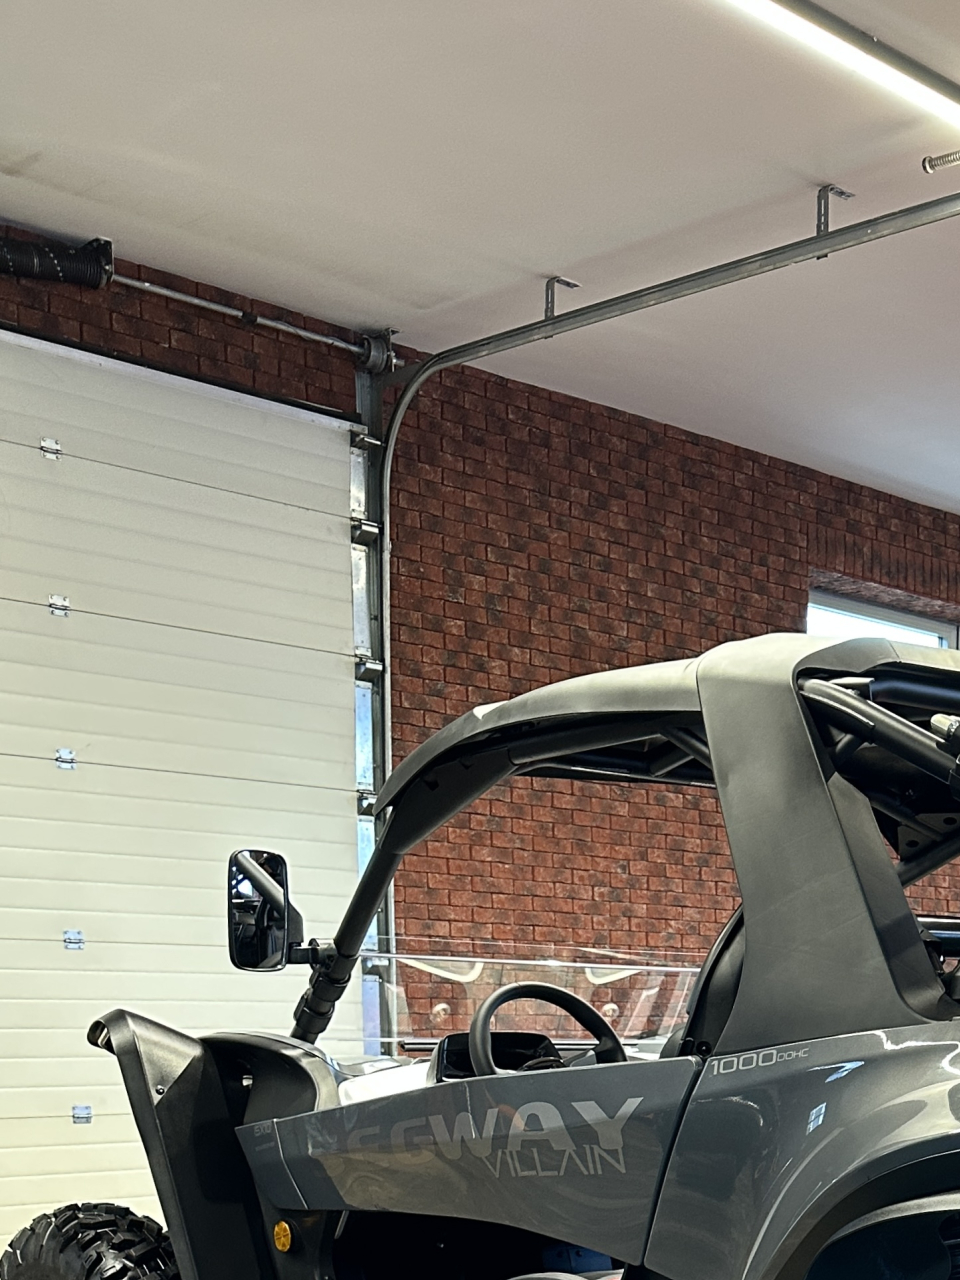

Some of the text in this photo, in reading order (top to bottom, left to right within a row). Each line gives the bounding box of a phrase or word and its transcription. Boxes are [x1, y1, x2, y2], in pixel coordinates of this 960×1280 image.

[711, 1048, 810, 1075] 1000 DOHC
[482, 1144, 626, 1178] VILLAIN
